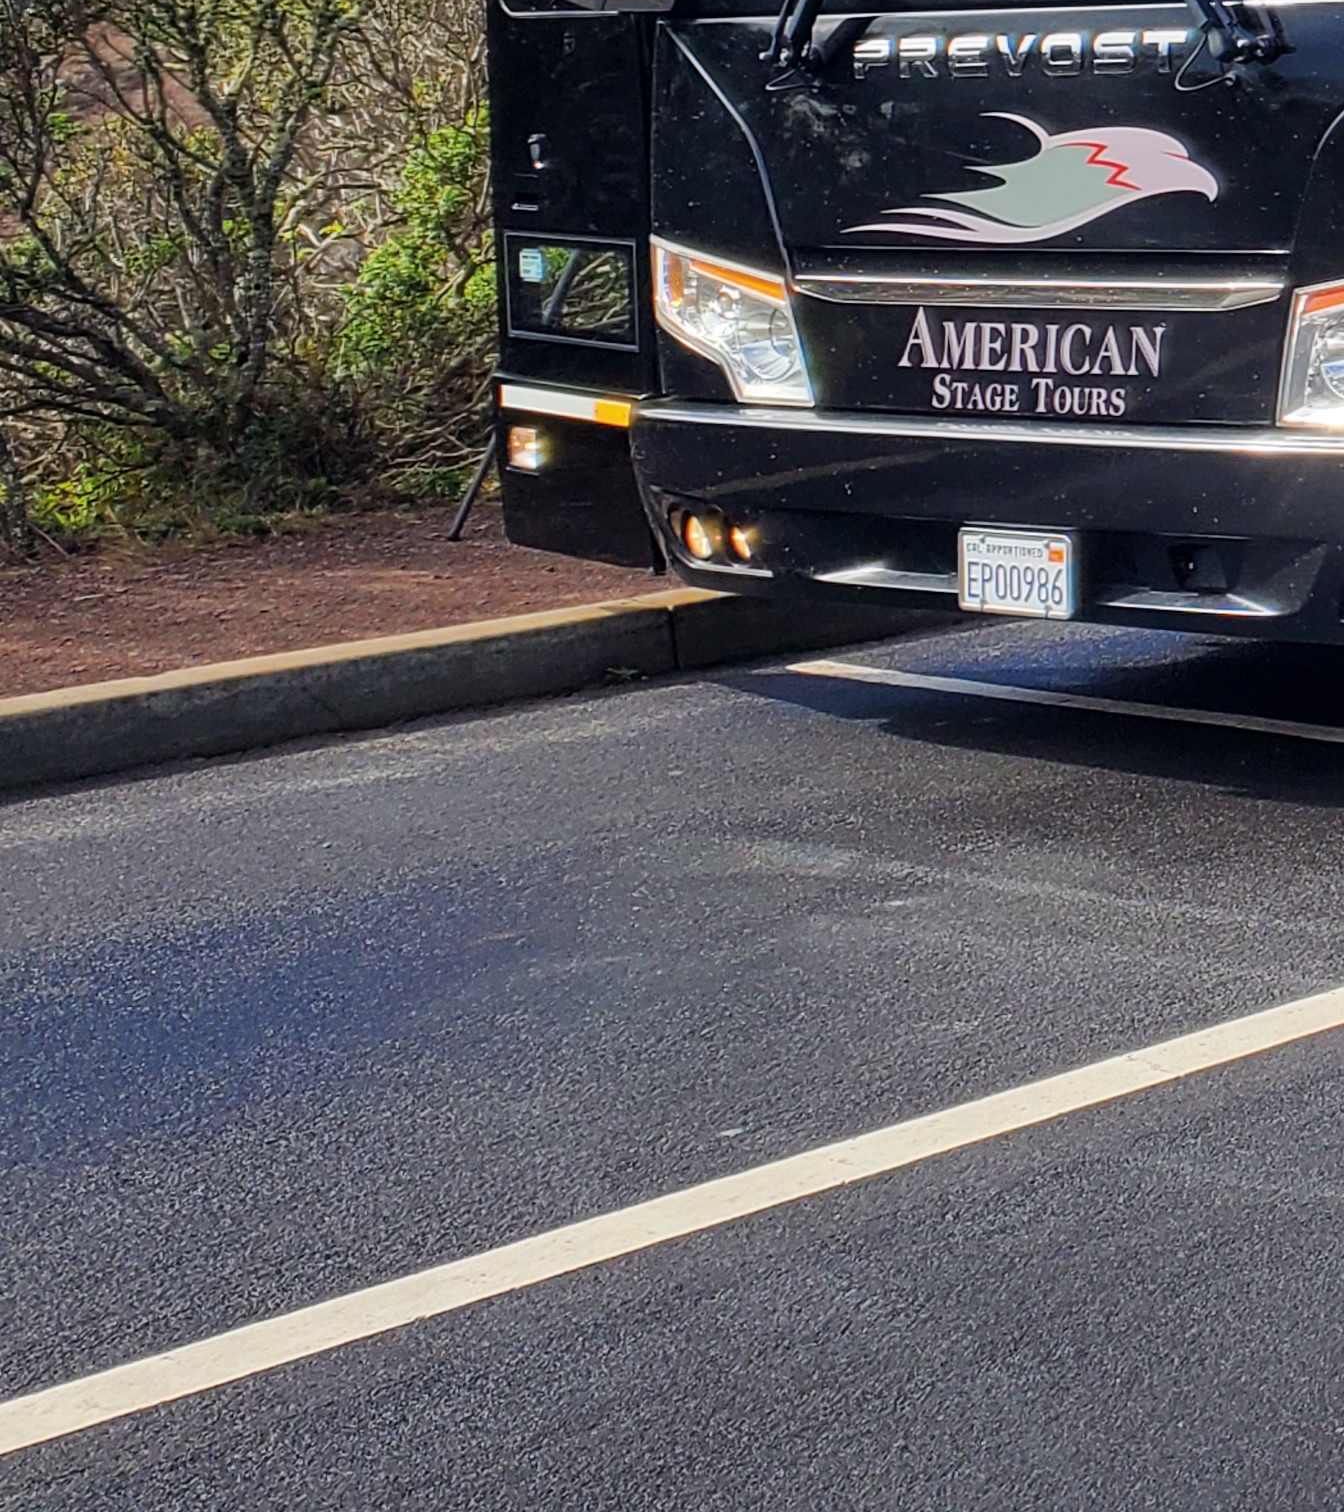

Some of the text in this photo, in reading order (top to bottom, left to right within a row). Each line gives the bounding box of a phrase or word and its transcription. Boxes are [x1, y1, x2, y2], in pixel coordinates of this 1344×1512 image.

[854, 31, 1187, 80] PREVOST
[897, 306, 1166, 377] AMERICAN
[931, 373, 1126, 417] STAGE TOURS
[966, 542, 983, 554] CAL
[967, 561, 1063, 605] EP00986
